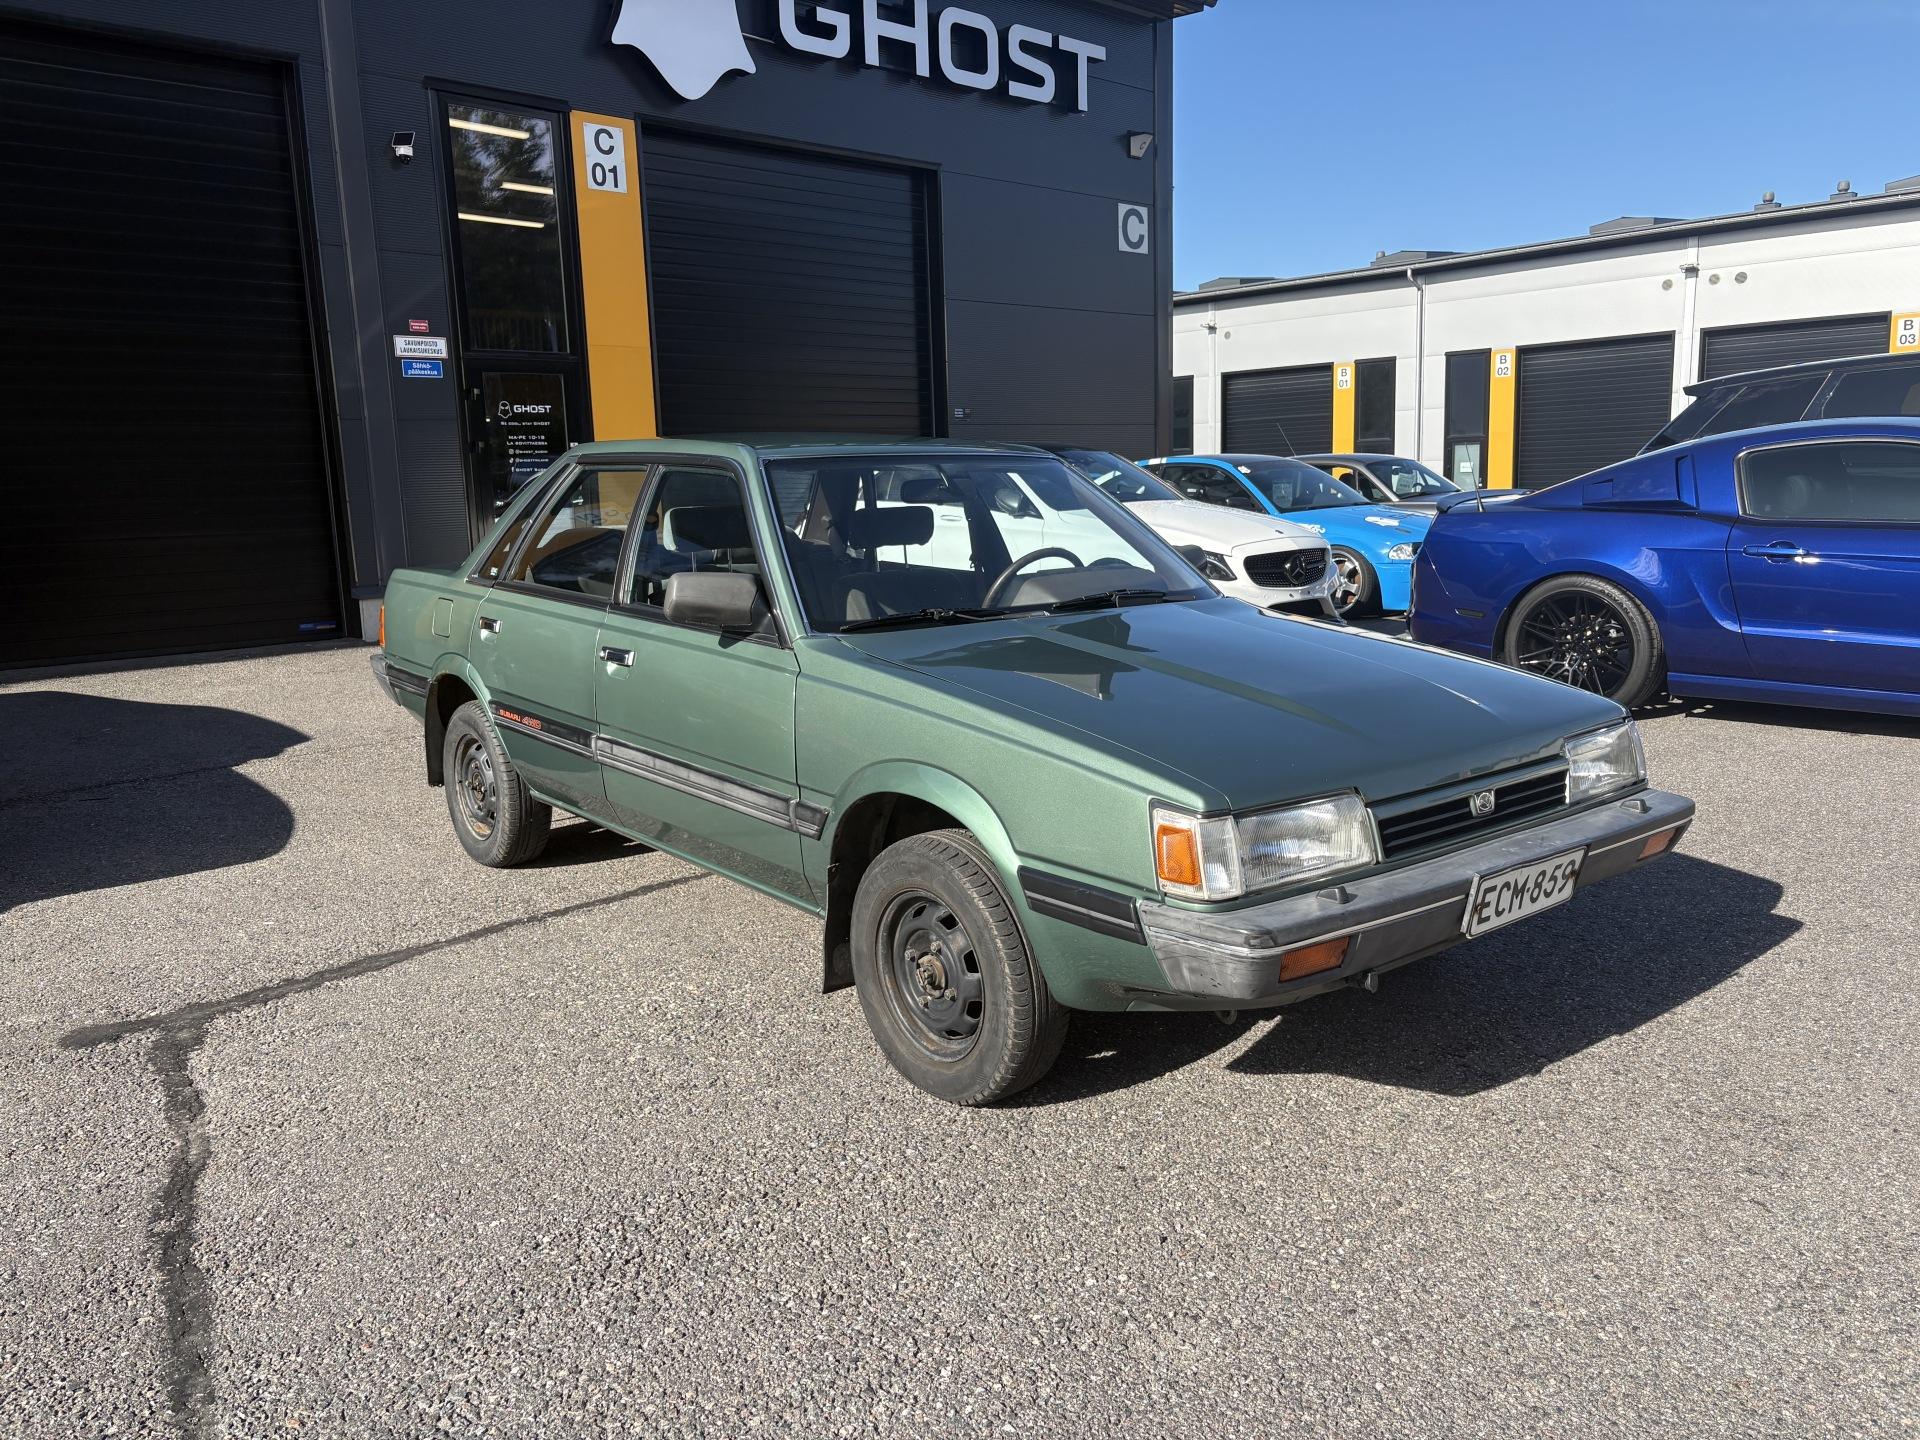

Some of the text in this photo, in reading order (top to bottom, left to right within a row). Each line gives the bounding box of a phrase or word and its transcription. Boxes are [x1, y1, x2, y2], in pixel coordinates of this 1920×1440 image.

[778, 0, 1107, 112] GHOST
[594, 128, 614, 155] C
[591, 162, 619, 188] 01
[1121, 207, 1145, 250] C
[1903, 319, 1914, 331] B
[1899, 333, 1916, 345] 03
[1499, 354, 1507, 364] B
[1340, 368, 1348, 377] B
[1497, 366, 1509, 376] 02
[1338, 379, 1348, 388] 01
[513, 405, 552, 413] GHOST
[500, 709, 520, 721] SUBARU
[1476, 859, 1576, 925] ECM-859
